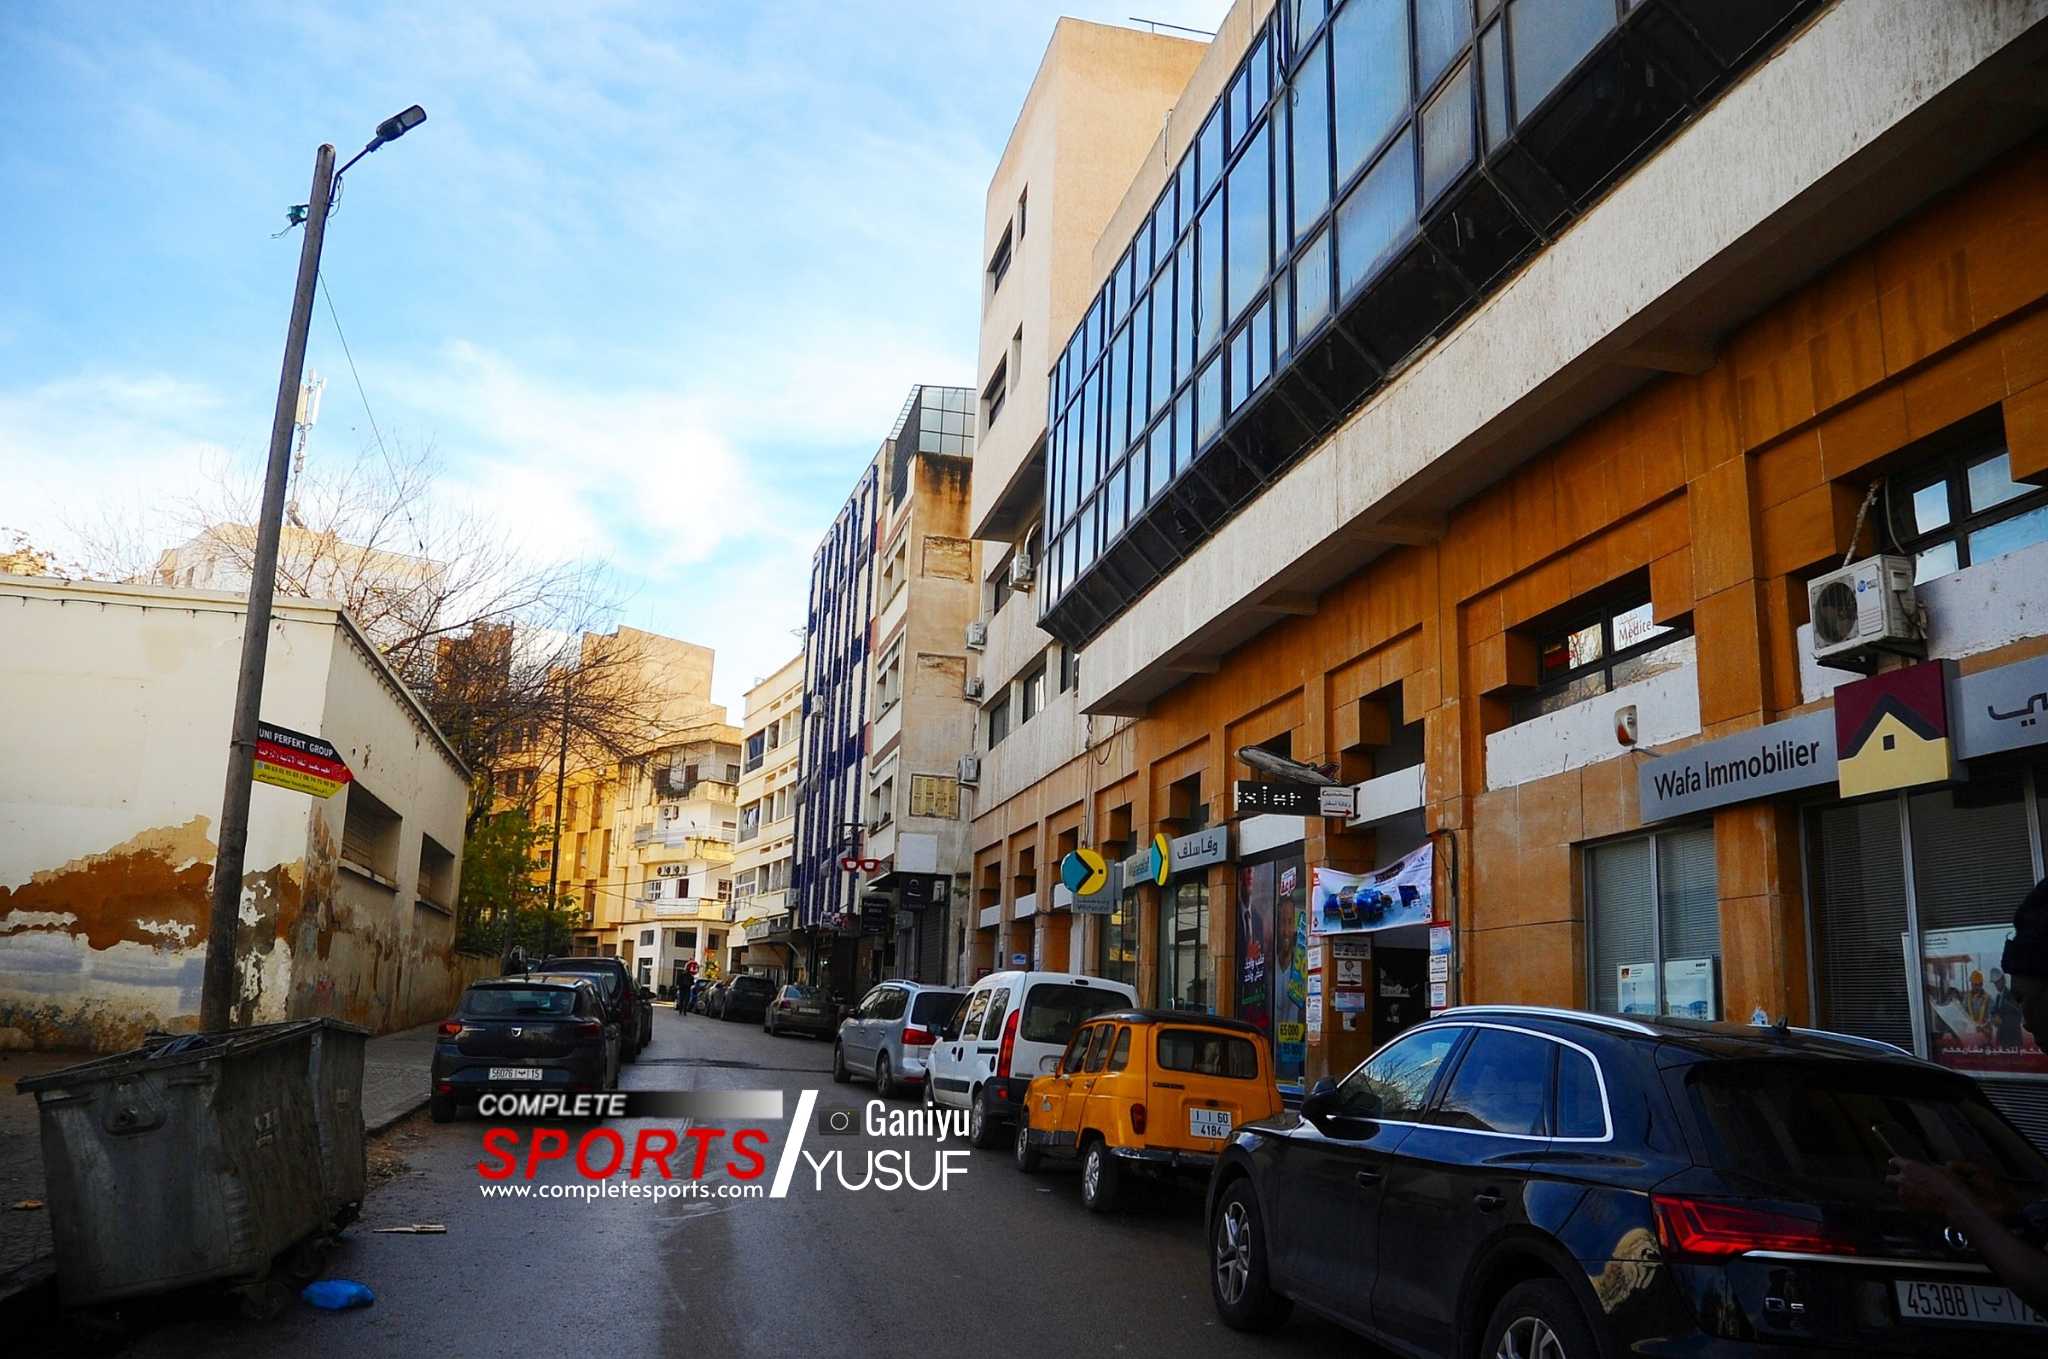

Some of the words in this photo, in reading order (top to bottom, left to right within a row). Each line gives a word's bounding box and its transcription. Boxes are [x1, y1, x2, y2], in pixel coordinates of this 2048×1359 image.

[258, 728, 273, 740] UNI
[274, 732, 306, 750] PERFEKT
[309, 743, 334, 757] GROUP
[1654, 766, 1701, 800] Wafa
[1705, 740, 1820, 788] Immobilier
[1200, 1124, 1222, 1137] 4184
[1908, 1282, 1969, 1317] 45388
